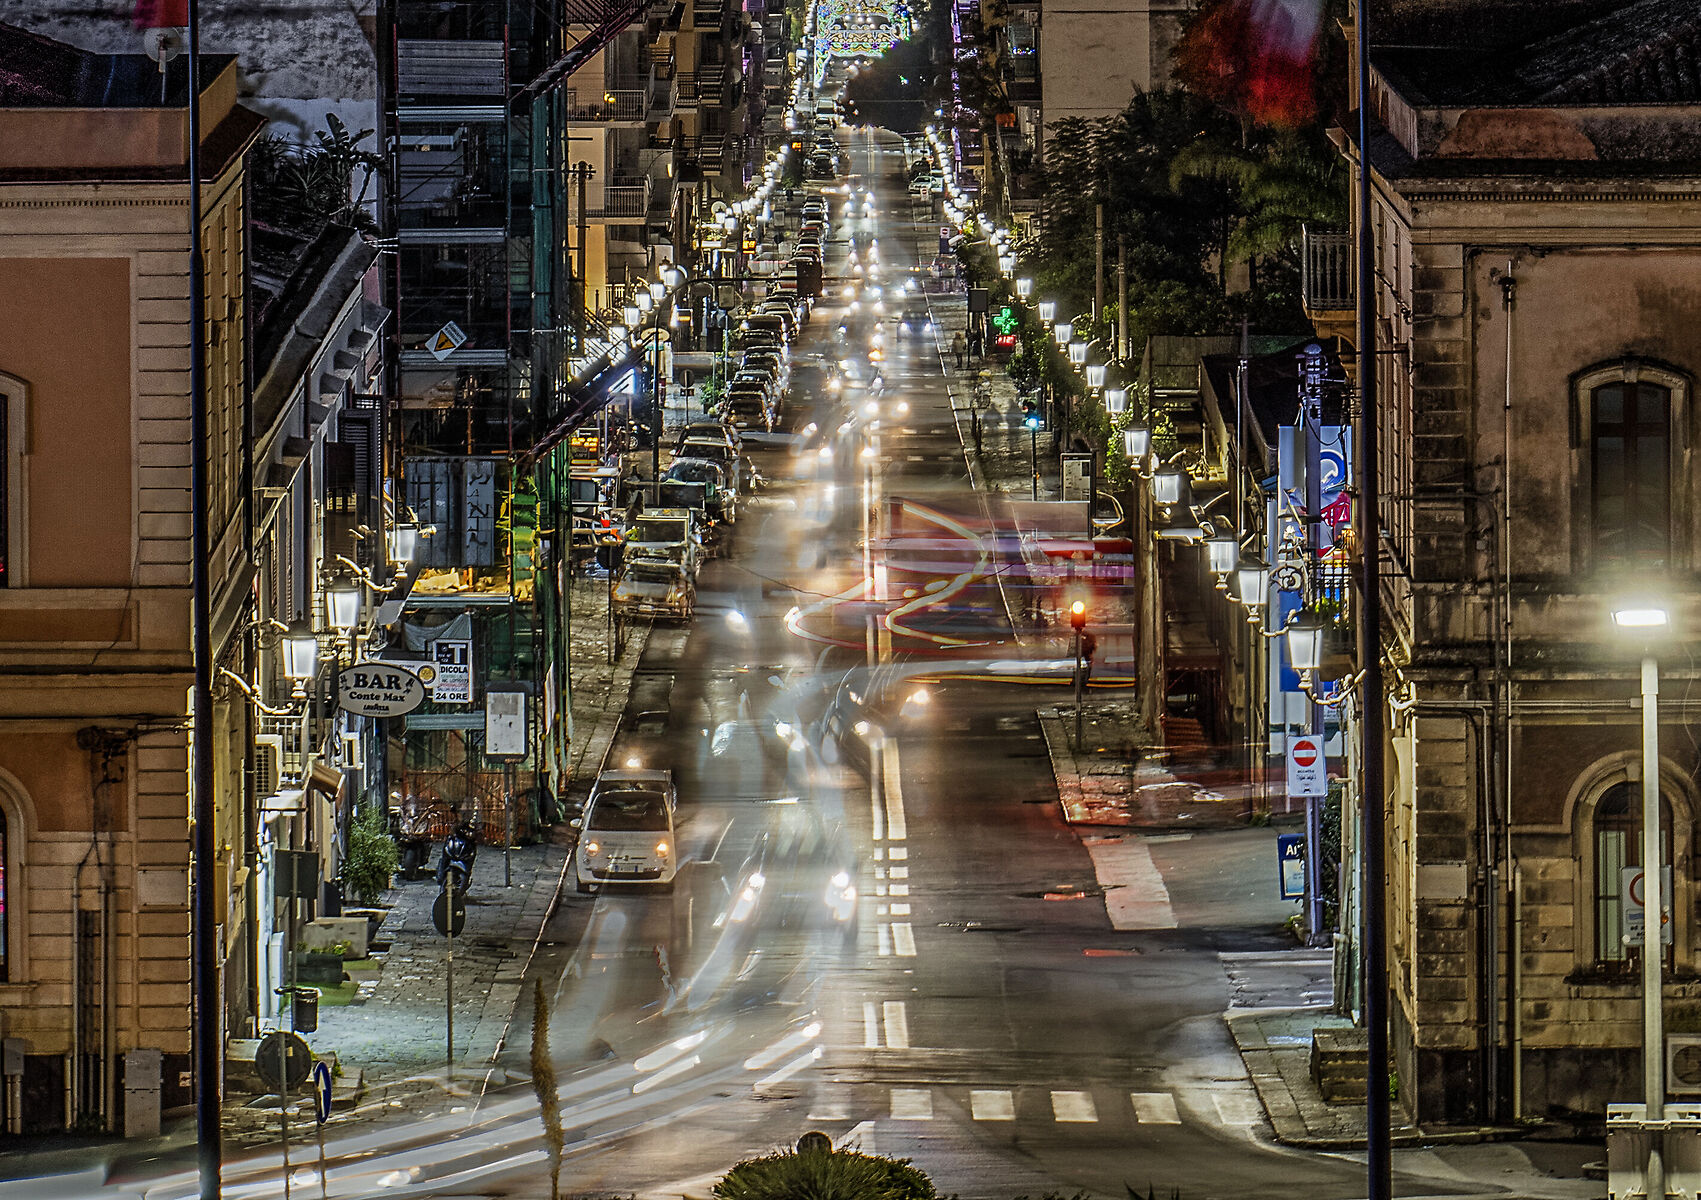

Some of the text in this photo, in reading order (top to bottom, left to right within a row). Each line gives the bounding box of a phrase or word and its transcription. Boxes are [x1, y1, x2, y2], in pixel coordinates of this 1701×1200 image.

[448, 644, 466, 664] T
[440, 666, 468, 674] DICOLA
[353, 673, 402, 690] BAR
[349, 691, 405, 702] Conte Max
[435, 692, 468, 700] 24 ORE
